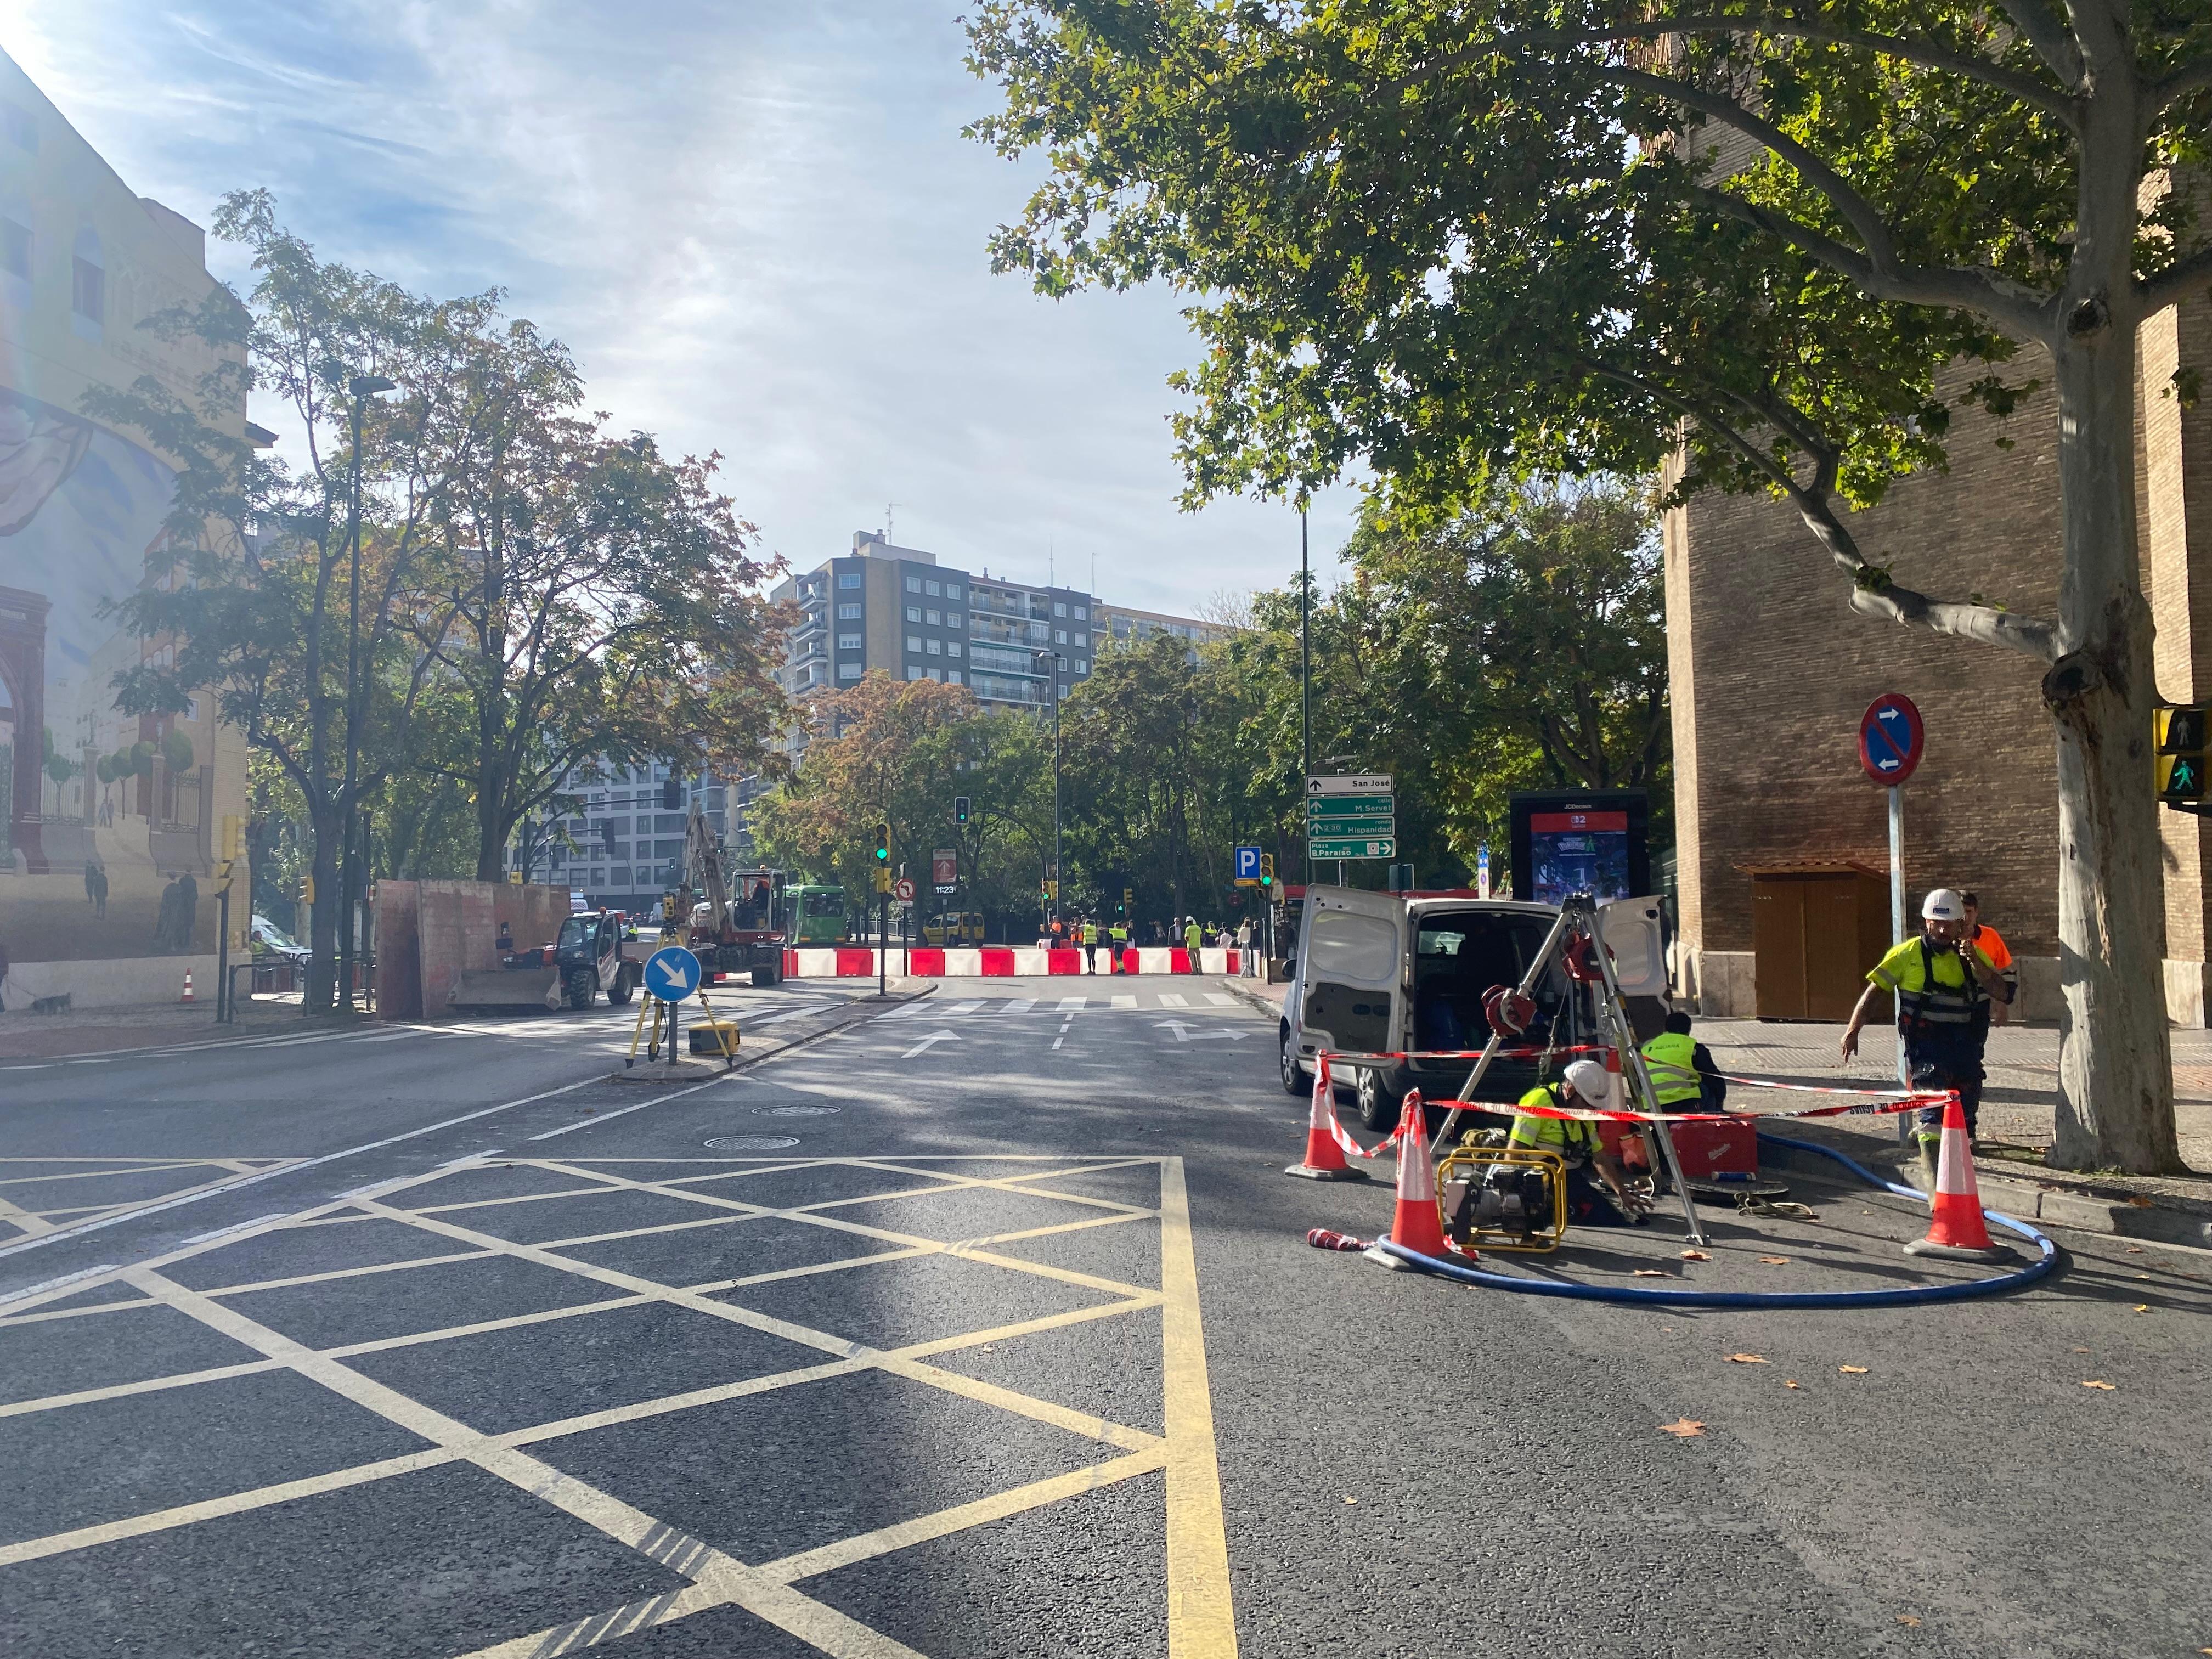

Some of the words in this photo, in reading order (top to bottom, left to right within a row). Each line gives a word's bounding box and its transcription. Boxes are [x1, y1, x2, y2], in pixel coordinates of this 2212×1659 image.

[1348, 826, 1391, 834] Hispanidad
[1240, 850, 1256, 876] P
[935, 885, 954, 894] 11:23
[1849, 1103, 1875, 1115] AGUAS
